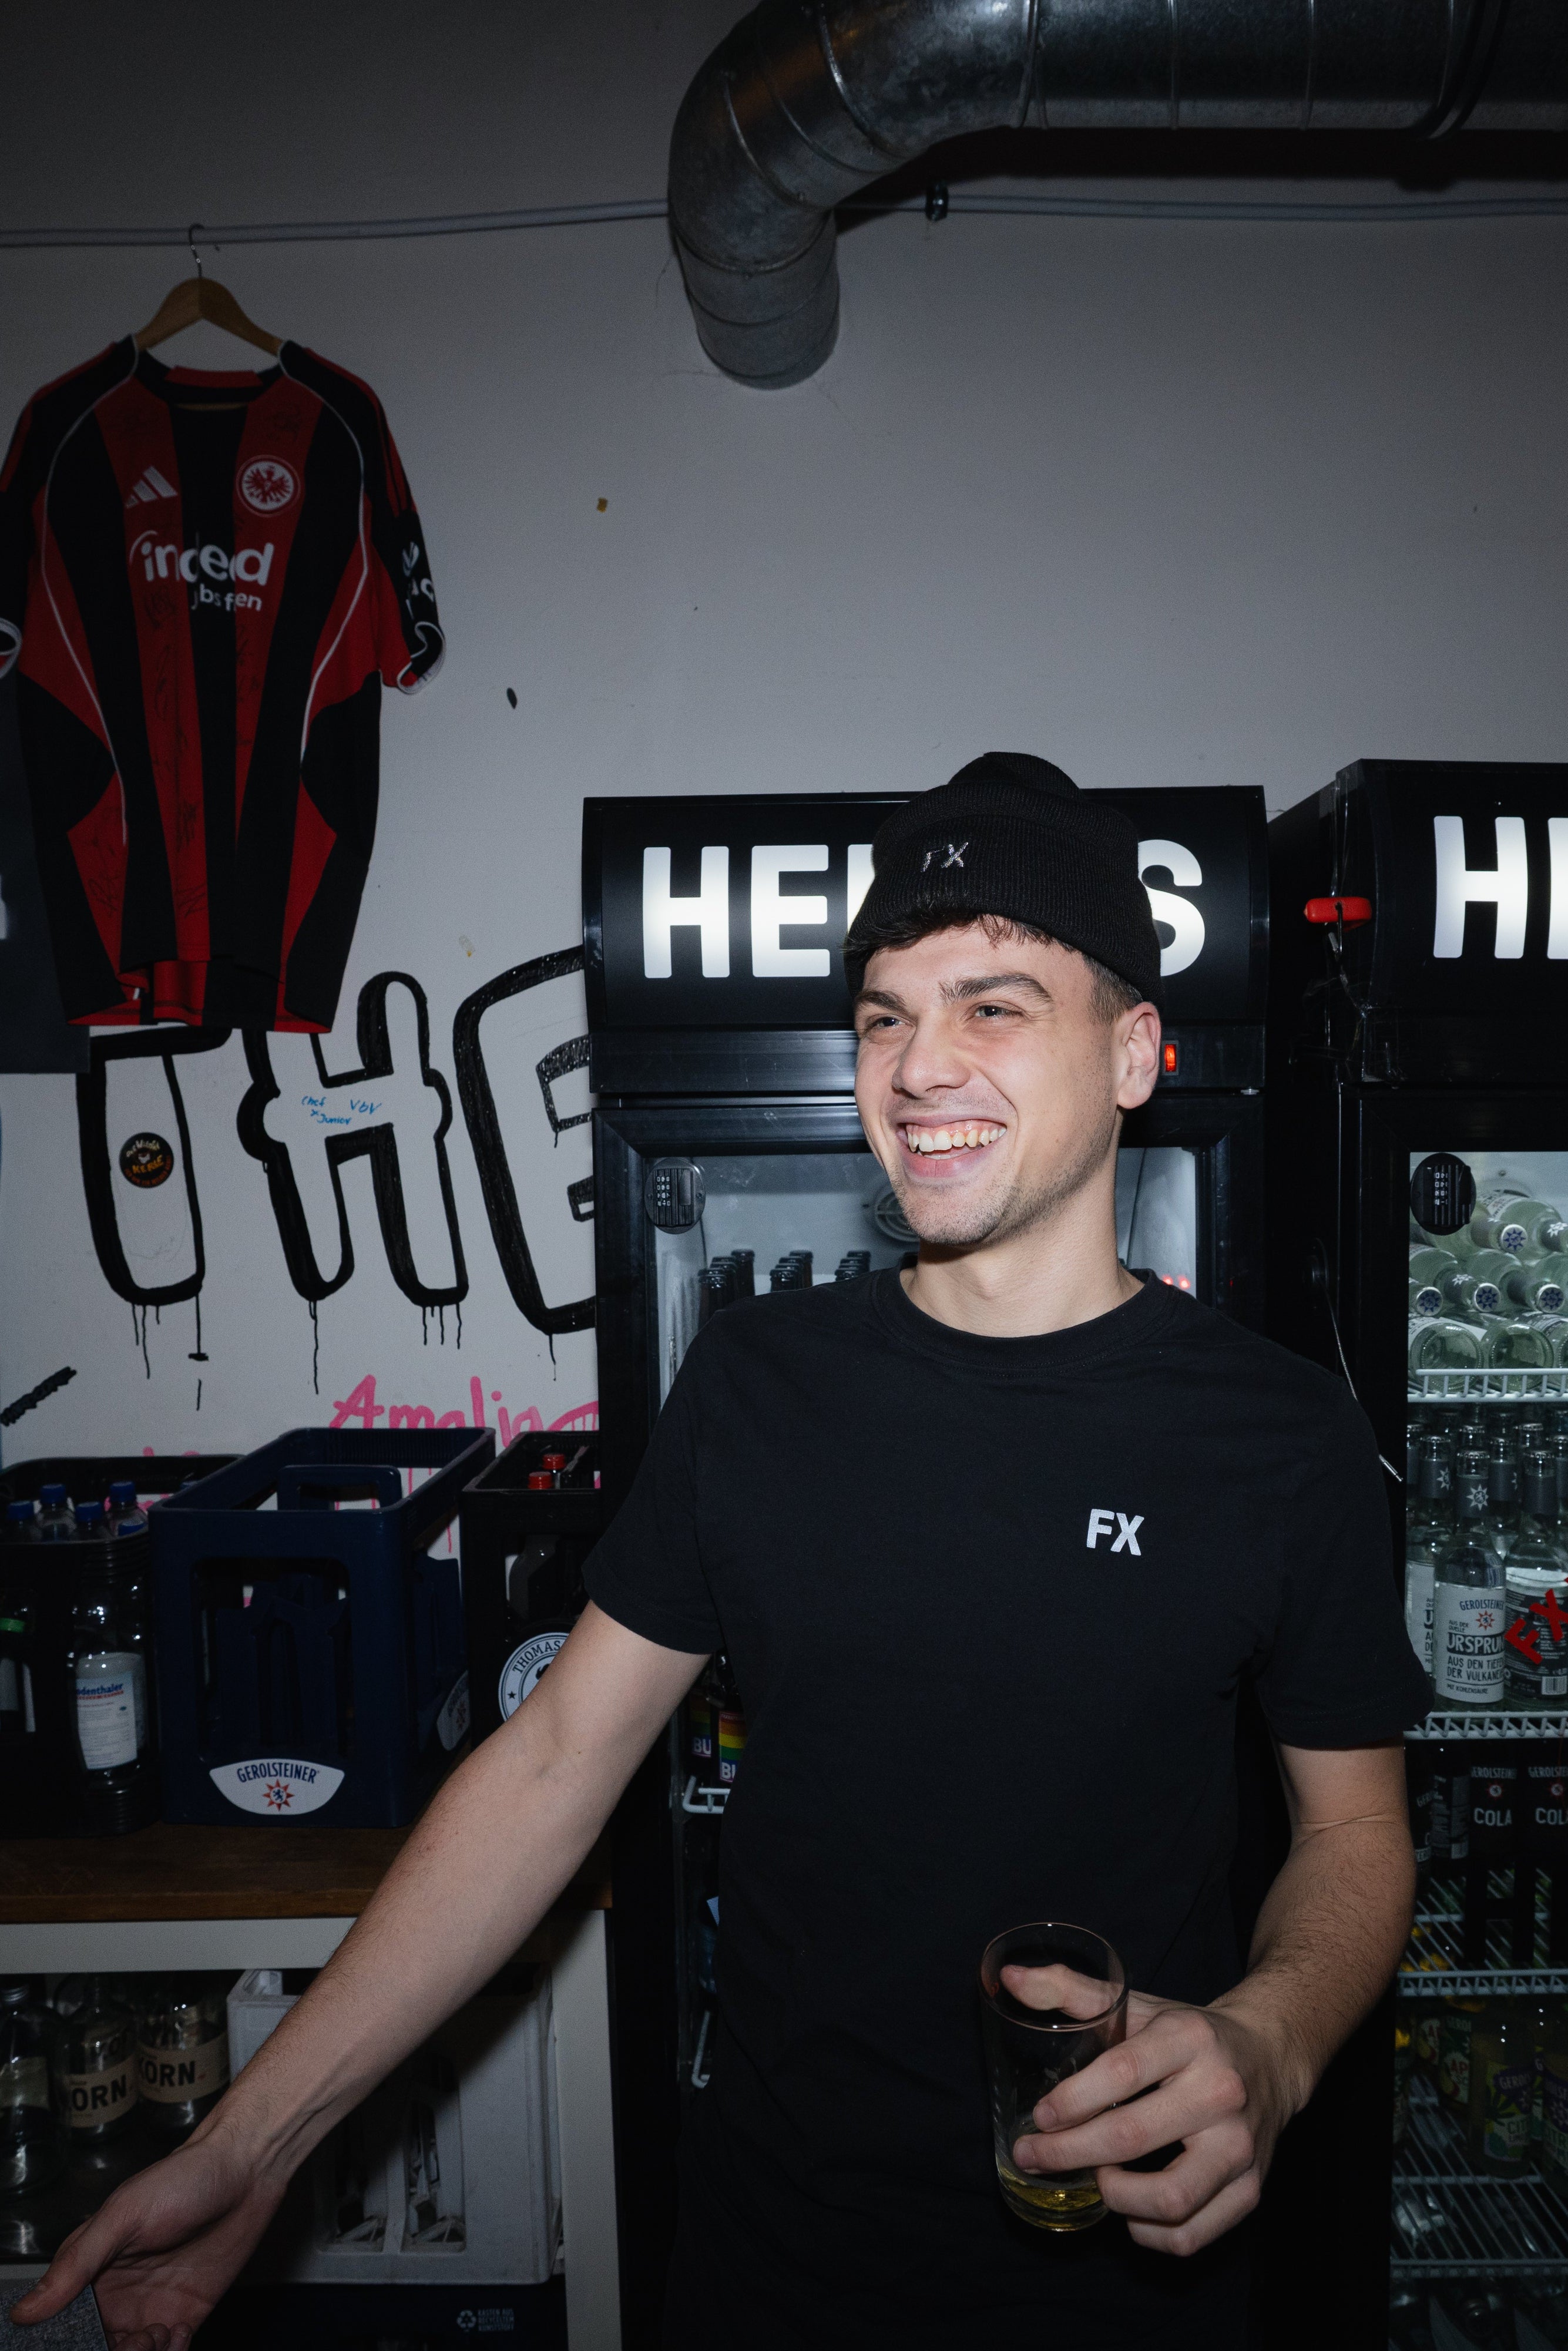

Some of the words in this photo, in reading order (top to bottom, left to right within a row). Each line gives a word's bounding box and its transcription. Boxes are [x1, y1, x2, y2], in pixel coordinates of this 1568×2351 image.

[1086, 1508, 1145, 1556] FX
[512, 1640, 561, 1675] THOMAS
[1448, 1655, 1464, 1668] AUS
[1467, 1659, 1483, 1670] DEN
[1447, 1667, 1463, 1678] DER
[237, 1762, 317, 1784] GEROLSTEINER
[1473, 1806, 1513, 1827] COLA
[72, 2074, 127, 2111] ORN
